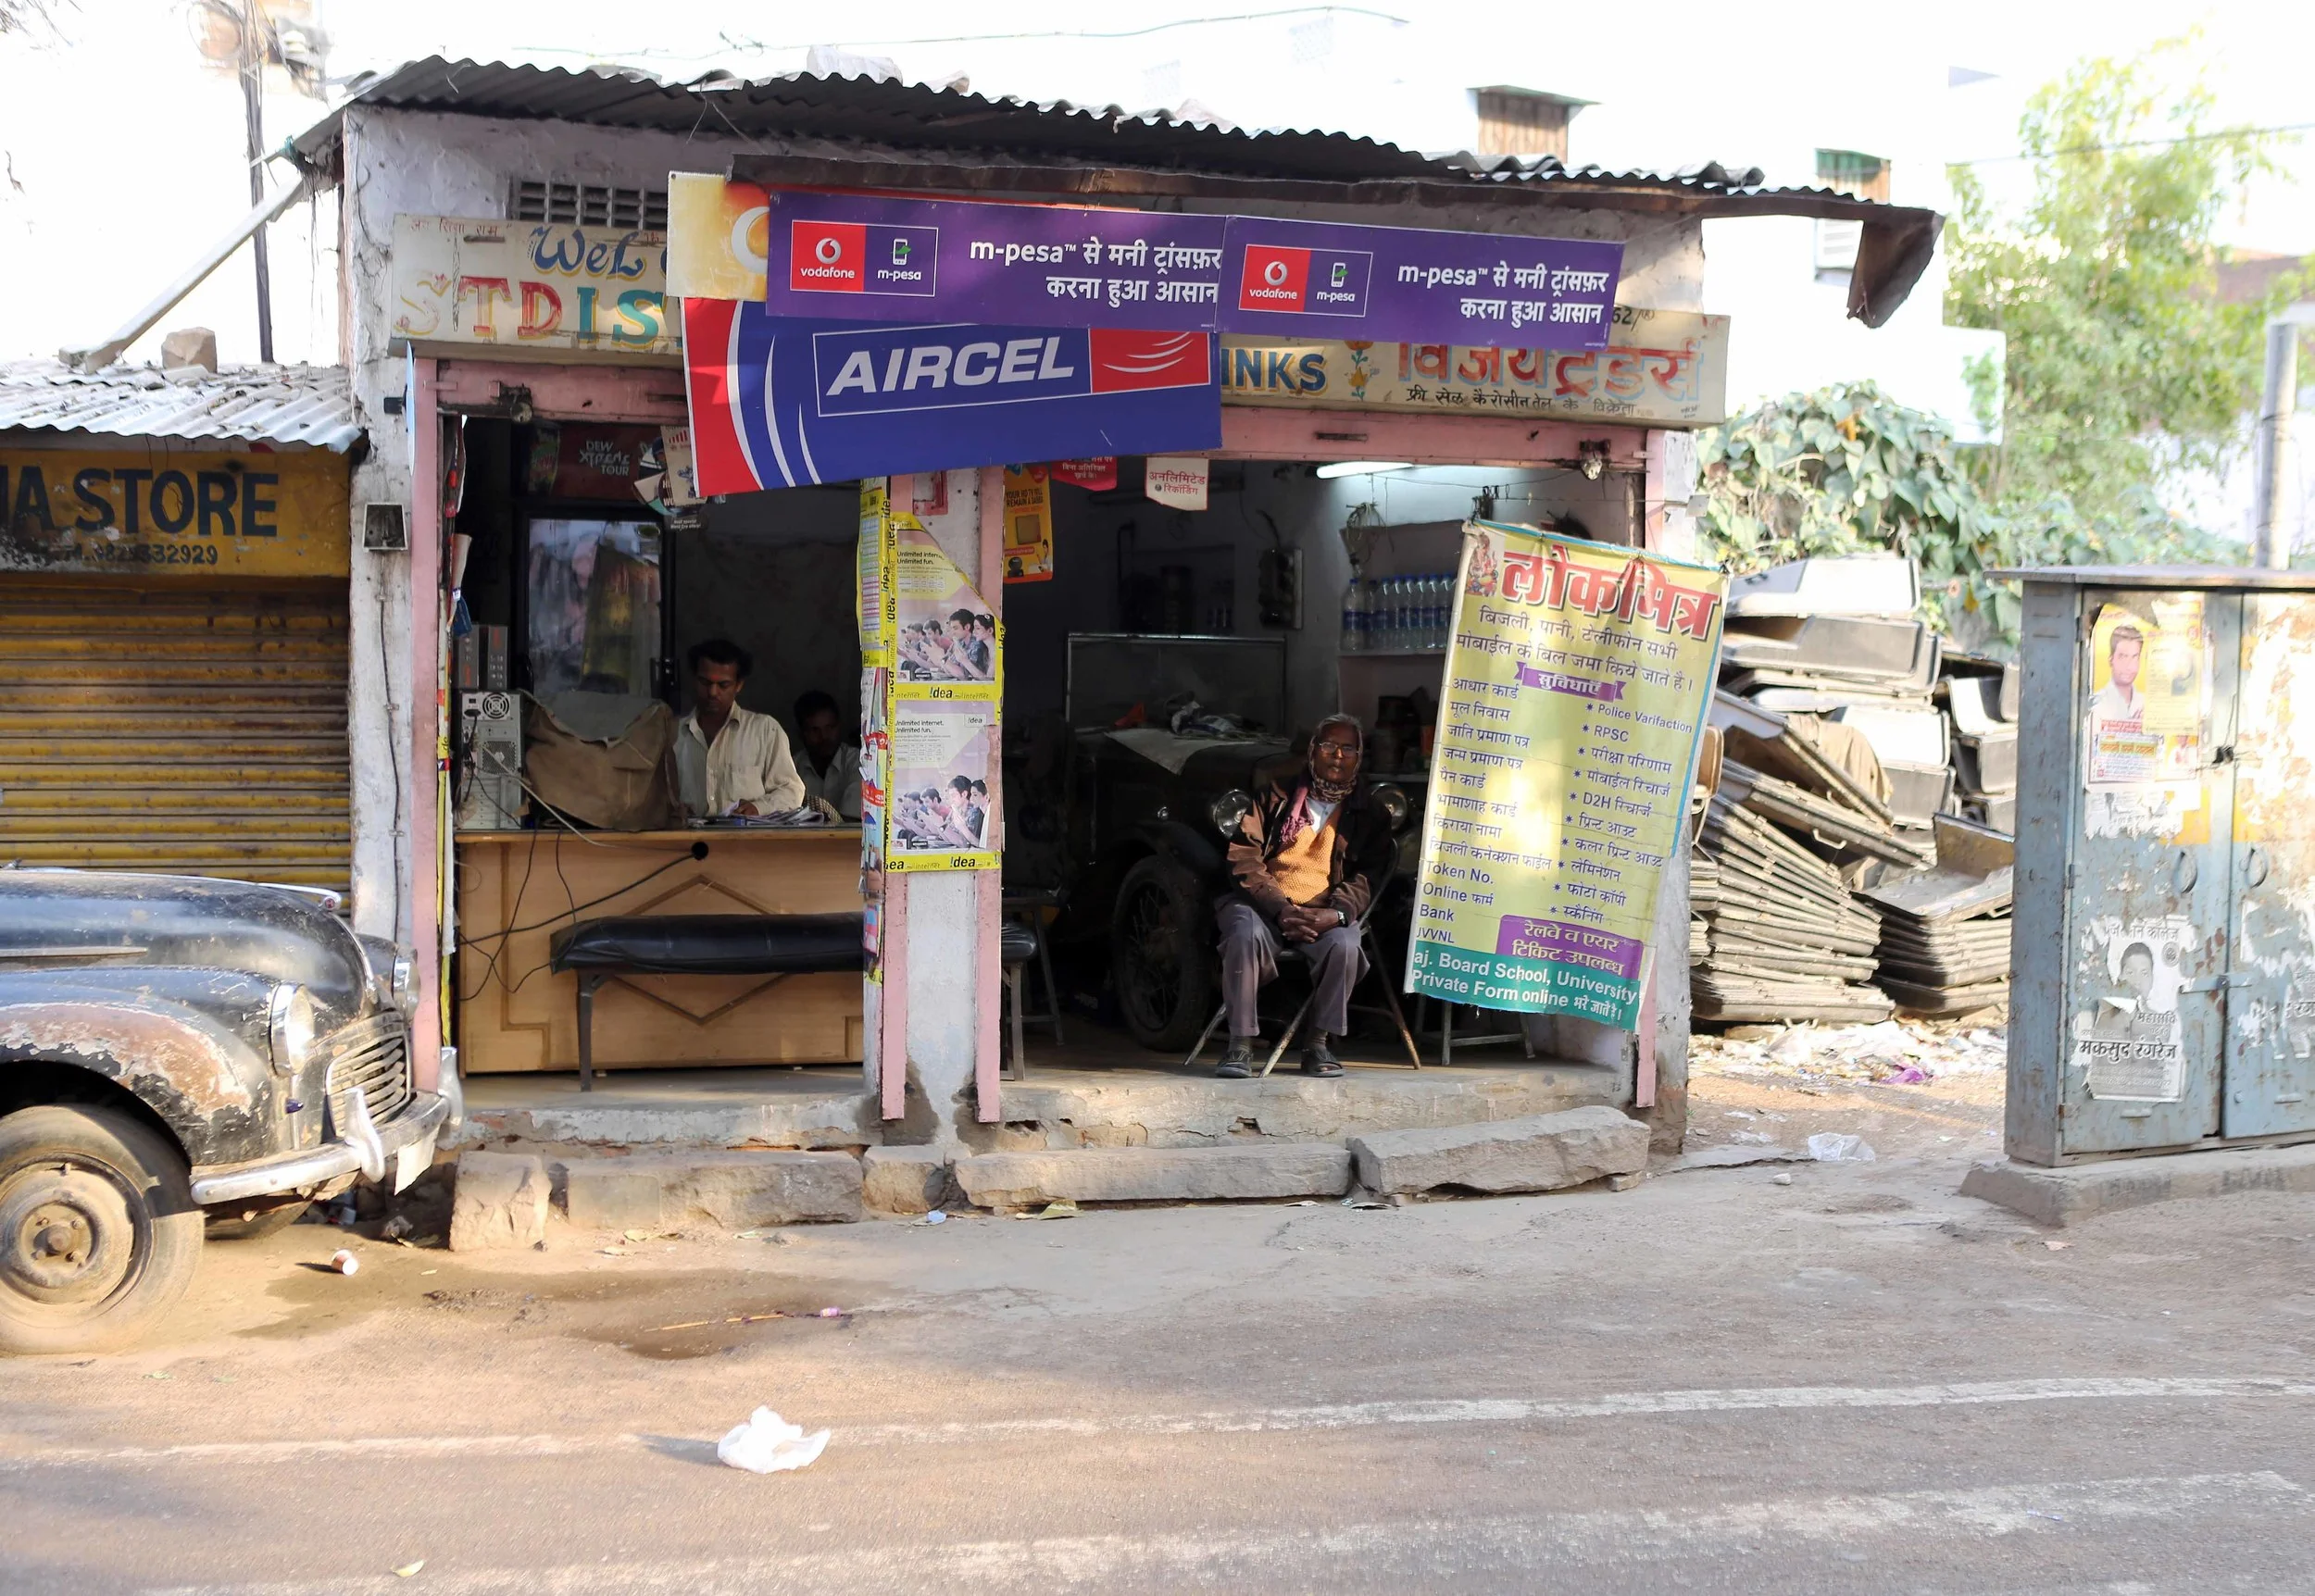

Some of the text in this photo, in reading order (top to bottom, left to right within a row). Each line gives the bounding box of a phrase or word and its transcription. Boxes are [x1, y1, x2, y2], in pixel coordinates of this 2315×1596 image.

[1082, 236, 1102, 266] से
[1108, 239, 1148, 268] मनी
[800, 266, 856, 280] vodafone
[877, 268, 922, 282] m-pesa
[1493, 260, 1509, 288] से
[1514, 263, 1547, 290] मनी
[1046, 276, 1219, 308] करना हुआ आसान
[1249, 287, 1297, 300] vodafone
[1316, 291, 1356, 303] m-pesa
[1460, 298, 1604, 329] करना हुआ आसान
[826, 336, 1074, 396] AIRCEL
[586, 441, 613, 452] DEW
[601, 466, 630, 476] TOUR
[73, 468, 278, 536] STORE
[1501, 544, 1720, 641] लोकमित्र
[1582, 625, 1643, 652] टेलीफोन
[1646, 639, 1678, 659] सभी
[1517, 641, 1532, 658] के
[1536, 642, 1567, 665] बिल
[1571, 653, 1603, 671] जमा
[1606, 654, 1636, 678] किये
[1641, 665, 1670, 686] जाते
[1453, 678, 1519, 699] आधार कार्ड
[1450, 701, 1510, 721] मूल निवास
[1598, 704, 1693, 733] Police Varifaction
[1446, 723, 1530, 748] जाति प्रमाण पत्र
[1594, 725, 1629, 742] RPSC
[1443, 747, 1523, 770] जन्म प्रमाण पत्र
[1591, 745, 1671, 774] परीक्षा परिणाम
[1440, 767, 1486, 789] पैन कार्ड
[1633, 777, 1671, 798] रिचार्ज
[1437, 793, 1518, 817] भामाशाह कार्ड
[1583, 792, 1652, 817] D2H रिचार्ज
[1433, 813, 1502, 839] किराया नामा
[1579, 811, 1637, 838] प्रिन्ट आउट
[1430, 835, 1468, 856] बिजली
[1470, 844, 1520, 865] कनेक्शन
[1575, 838, 1663, 867] कलर प्रिन्ट आउट
[1426, 860, 1494, 884] Token No.
[1570, 857, 1621, 881] लेमिनेशन
[1423, 882, 1468, 902] Online
[1567, 881, 1627, 907] फोटो कॉपी
[1420, 904, 1455, 922] Bank
[1417, 928, 1455, 943] JVVNL
[1524, 919, 1620, 953] रेलवे व एयर
[1512, 940, 1623, 976] टिकिट उपलब्ध
[1413, 970, 1469, 993] Private
[1473, 981, 1519, 1001] Form
[1521, 989, 1569, 1008] online
[1439, 953, 1490, 976] Board
[1494, 963, 1551, 985] School,
[1557, 970, 1637, 1004] University
